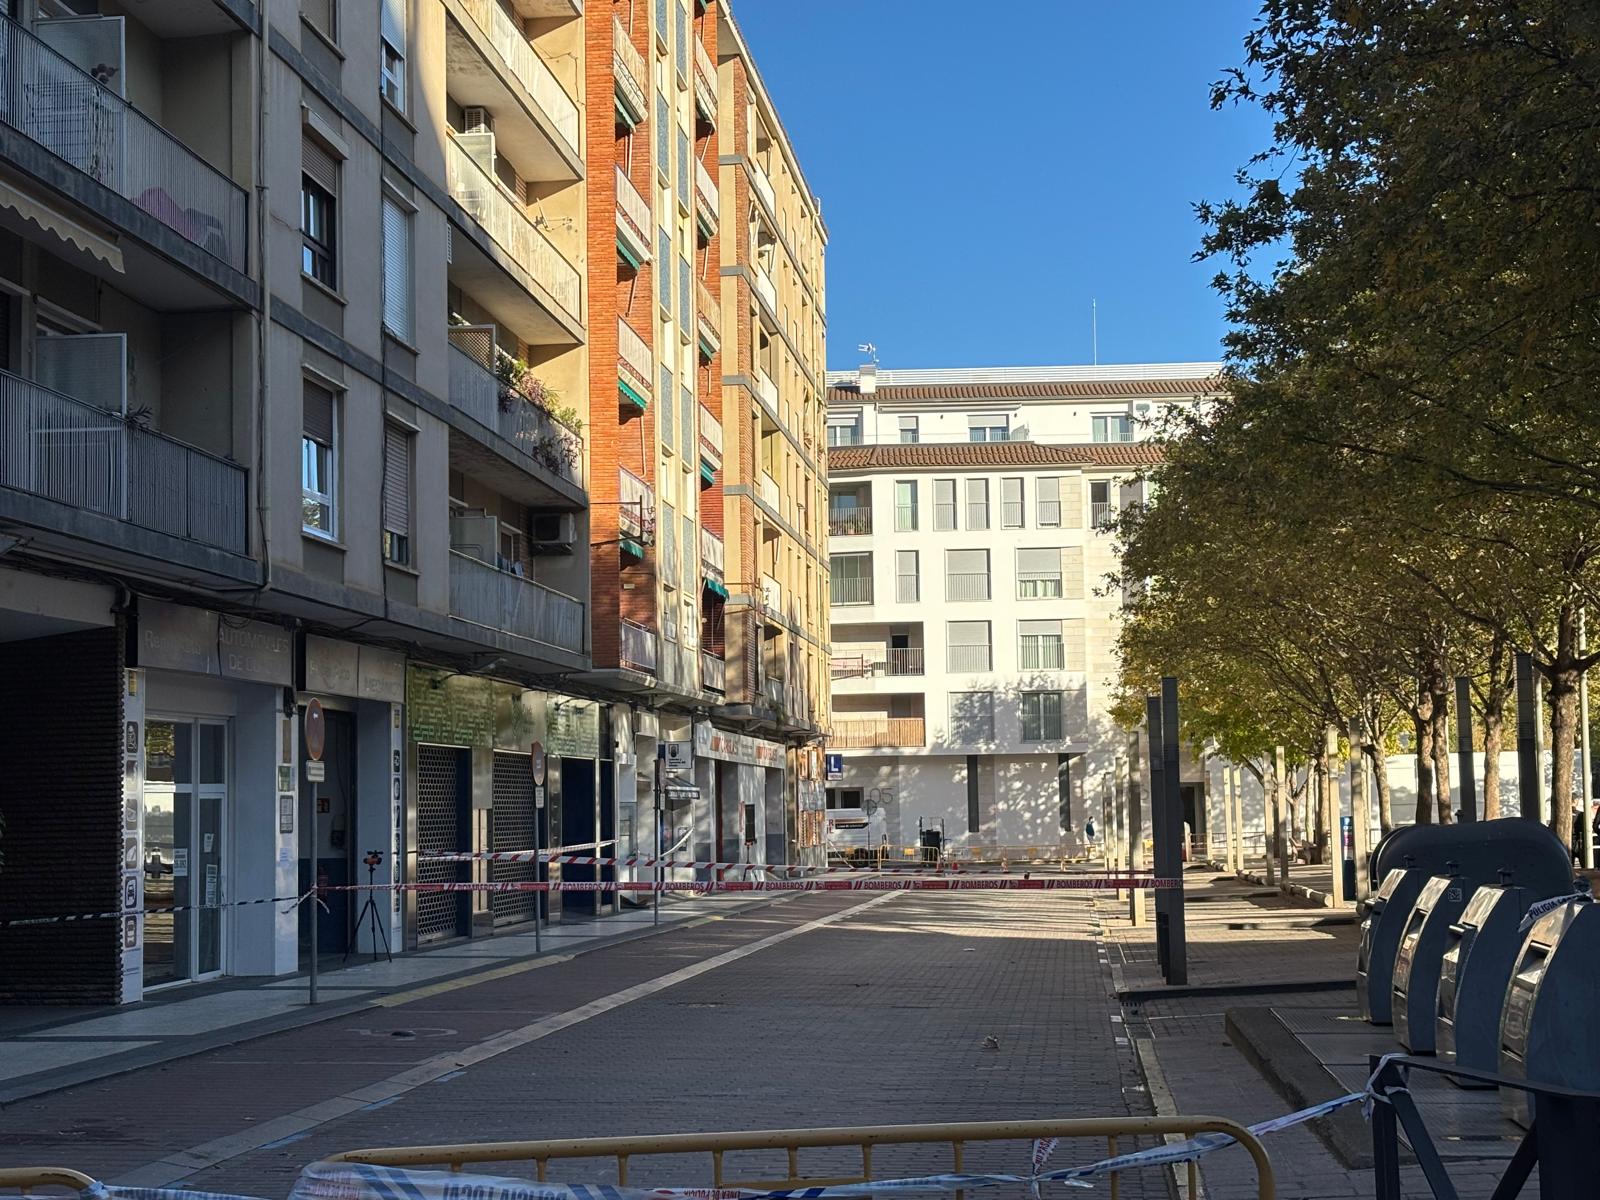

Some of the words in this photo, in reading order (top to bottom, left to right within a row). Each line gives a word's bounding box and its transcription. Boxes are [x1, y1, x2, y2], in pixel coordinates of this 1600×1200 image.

[831, 755, 839, 772] L
[870, 788, 893, 805] 05
[562, 883, 602, 891] BOMBEROS
[665, 882, 704, 890] BOMBEROS
[766, 882, 804, 890] BOMBEROS
[864, 881, 901, 889] BOMBEROS
[961, 881, 998, 889] BOMBEROS
[1056, 880, 1093, 888] BOMBEROS
[1151, 879, 1183, 888] BOMBERO
